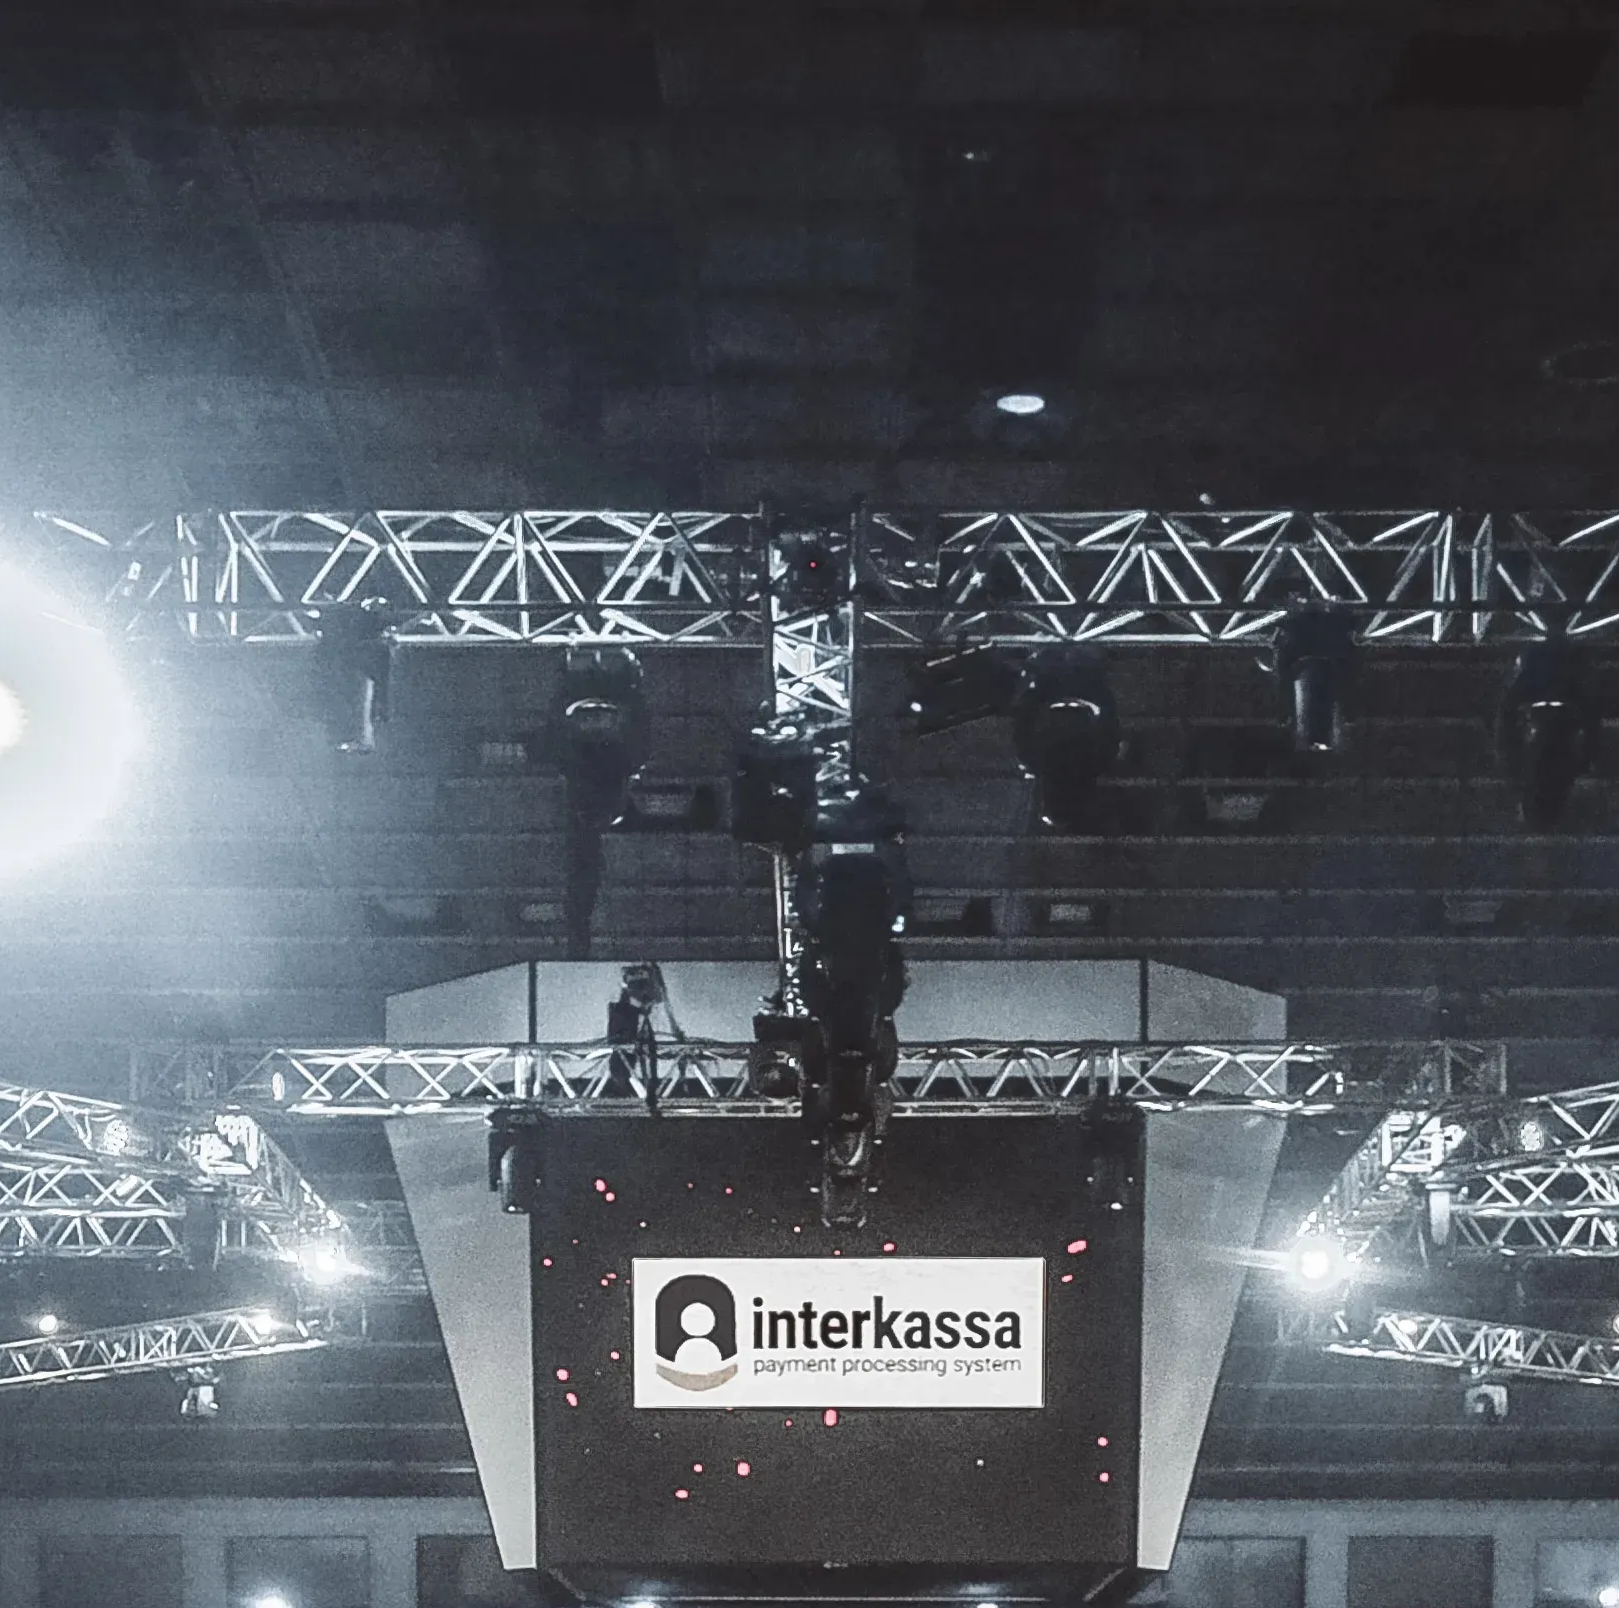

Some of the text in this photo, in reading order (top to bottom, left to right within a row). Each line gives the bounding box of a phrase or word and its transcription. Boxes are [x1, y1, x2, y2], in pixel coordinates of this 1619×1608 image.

[752, 1296, 1022, 1350] interkassa
[753, 1357, 1022, 1377] payment processing system
